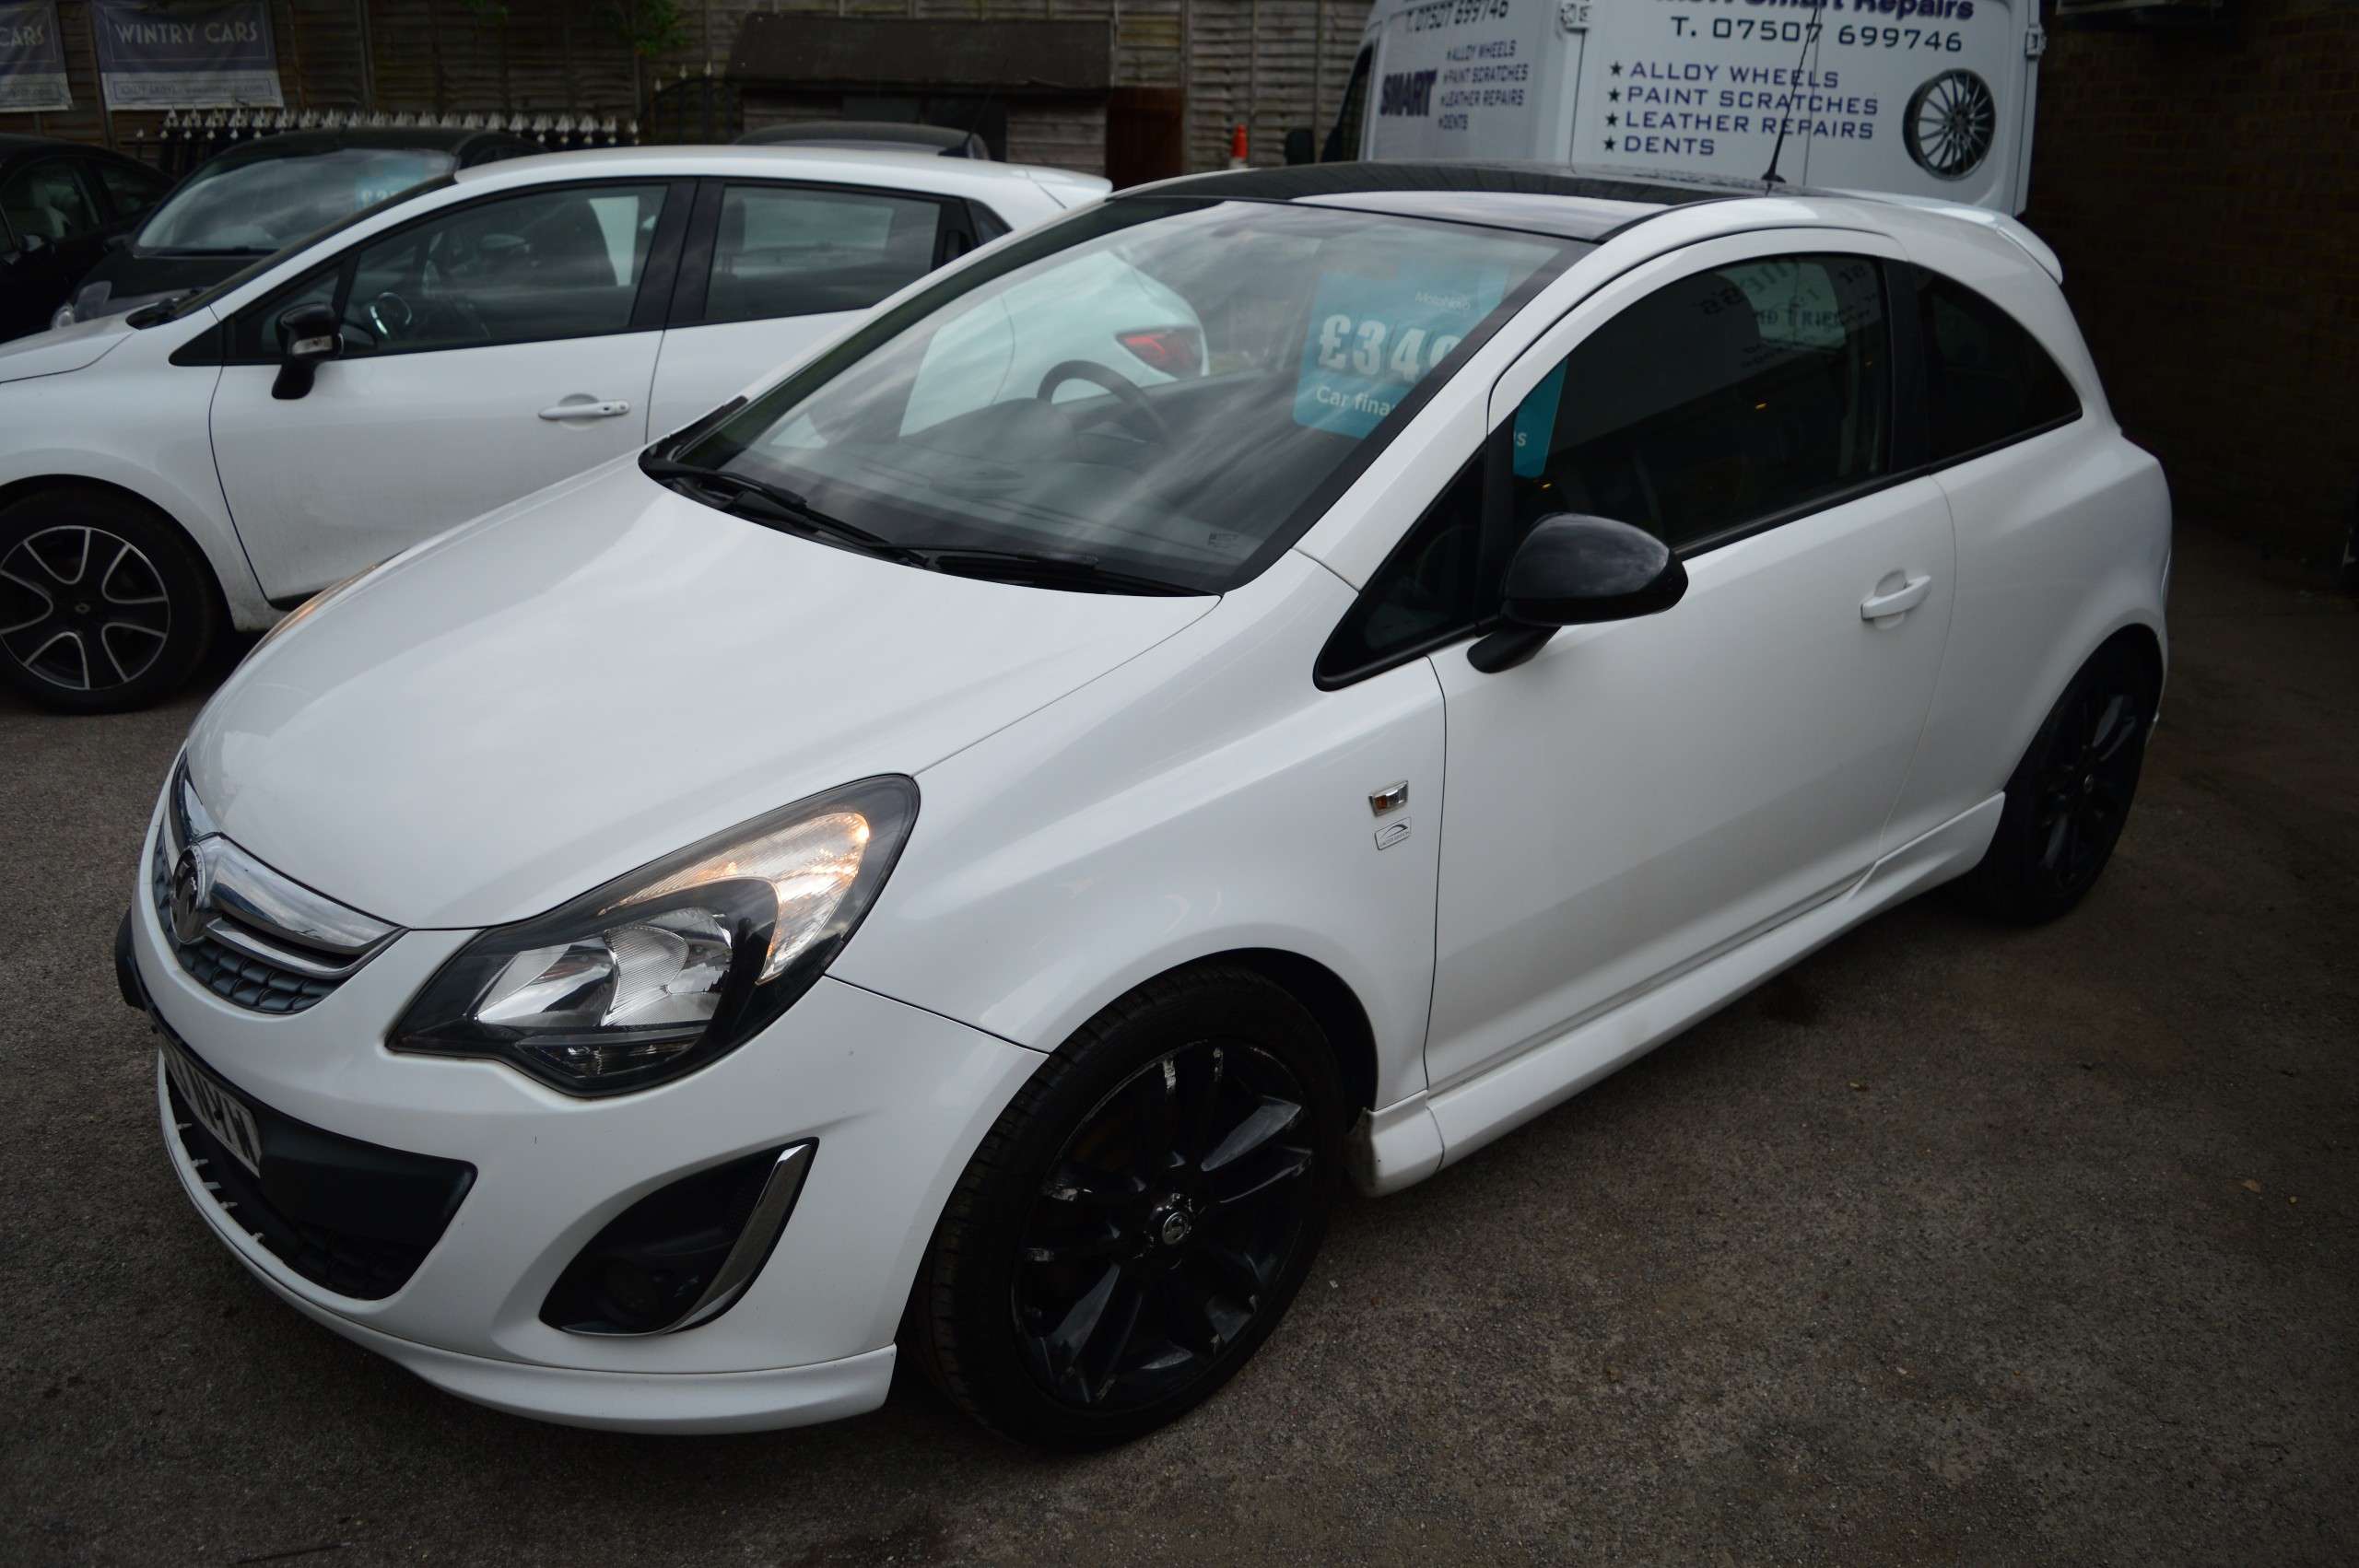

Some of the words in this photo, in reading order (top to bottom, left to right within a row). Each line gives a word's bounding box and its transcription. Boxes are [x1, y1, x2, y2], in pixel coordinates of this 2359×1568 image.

[115, 23, 198, 44] WINTRY
[205, 22, 258, 43] CARS
[1670, 16, 1697, 39] T.
[1712, 18, 1823, 45] 07507
[1838, 25, 1963, 53] 699746
[1629, 61, 1720, 83] ALLOY
[1730, 65, 1839, 89] WHEELS
[1626, 86, 1708, 107] PAINT
[1719, 90, 1879, 116] SCRATCHES
[1625, 111, 1750, 135] LEATHER
[1761, 117, 1874, 141] REPAIRS
[1624, 135, 1716, 157] DENTS
[1316, 386, 1346, 408] Car
[1354, 392, 1396, 416] fina
